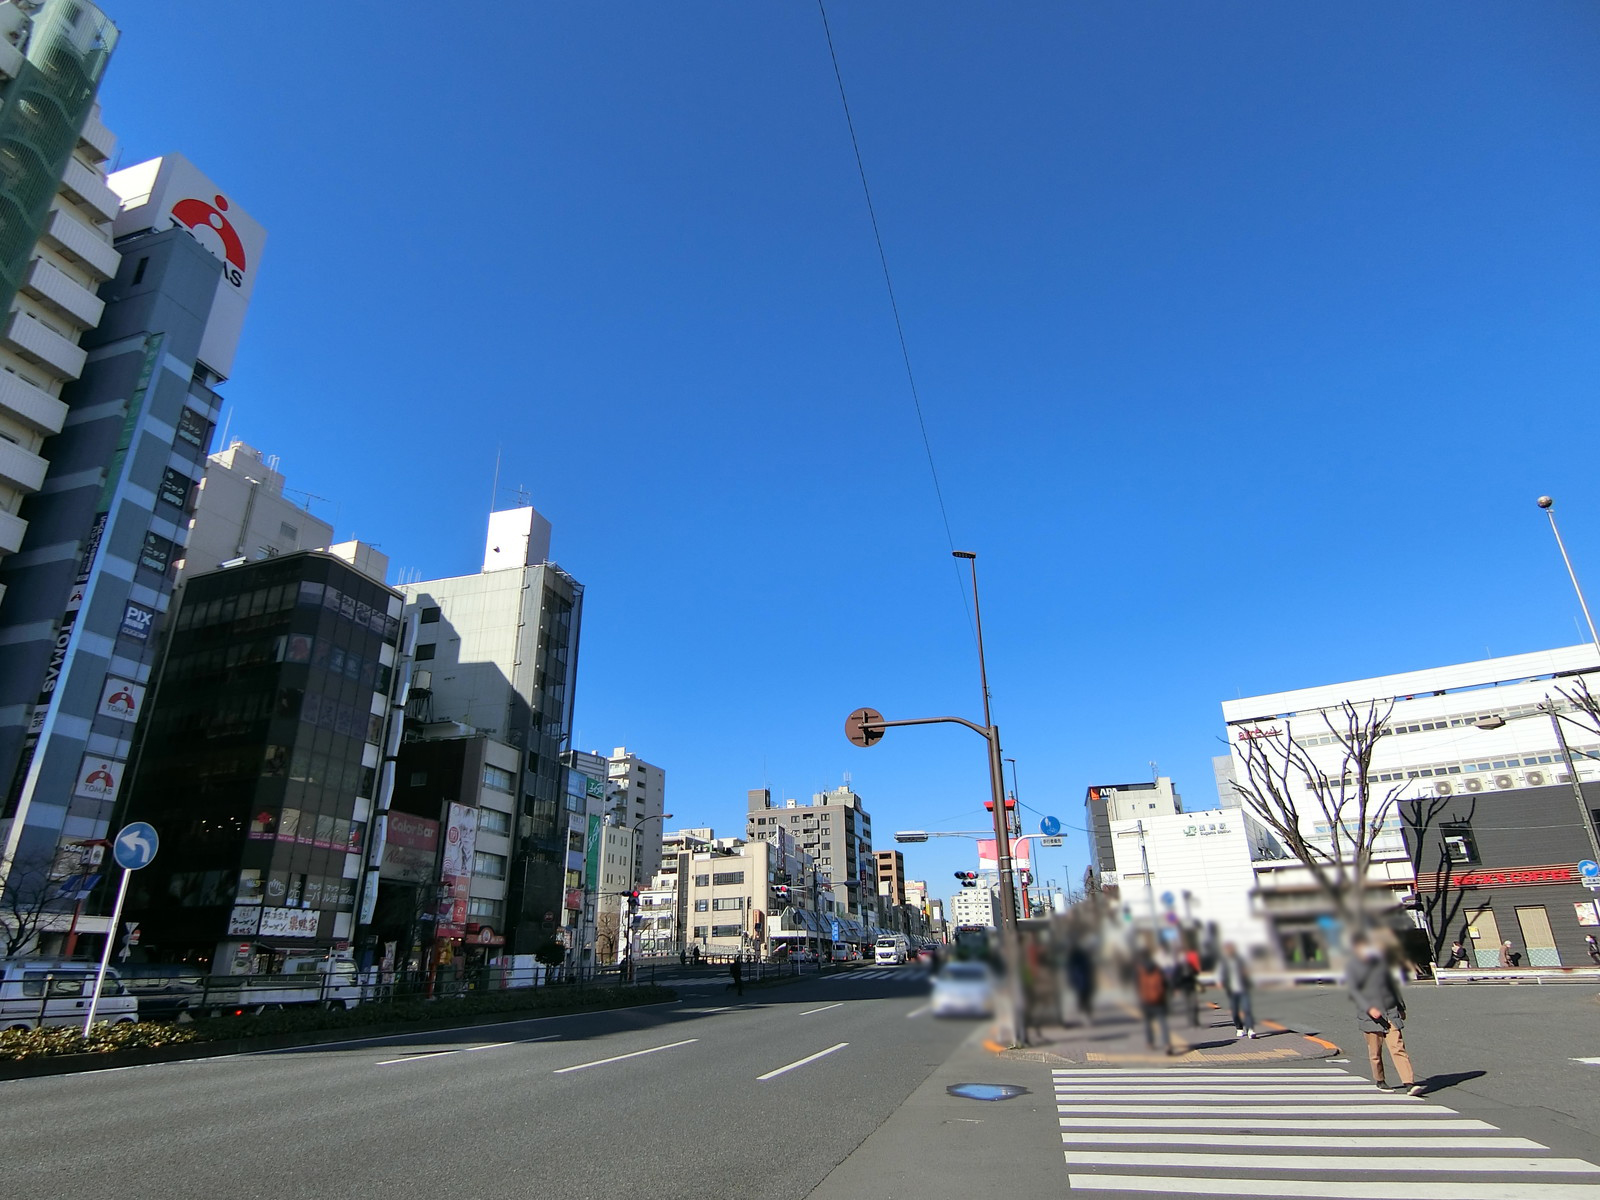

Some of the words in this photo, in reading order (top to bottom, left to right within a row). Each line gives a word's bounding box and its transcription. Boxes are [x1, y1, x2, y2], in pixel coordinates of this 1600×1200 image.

[126, 606, 154, 626] PIX
[41, 619, 76, 694] TOMAS
[105, 703, 135, 717] TOMAS
[84, 784, 113, 795] TOMAS
[1453, 873, 1507, 886] BECK'S
[1509, 869, 1571, 882] COFFEE
[231, 917, 258, 926] ラーメン
[261, 920, 287, 932] ラーメン
